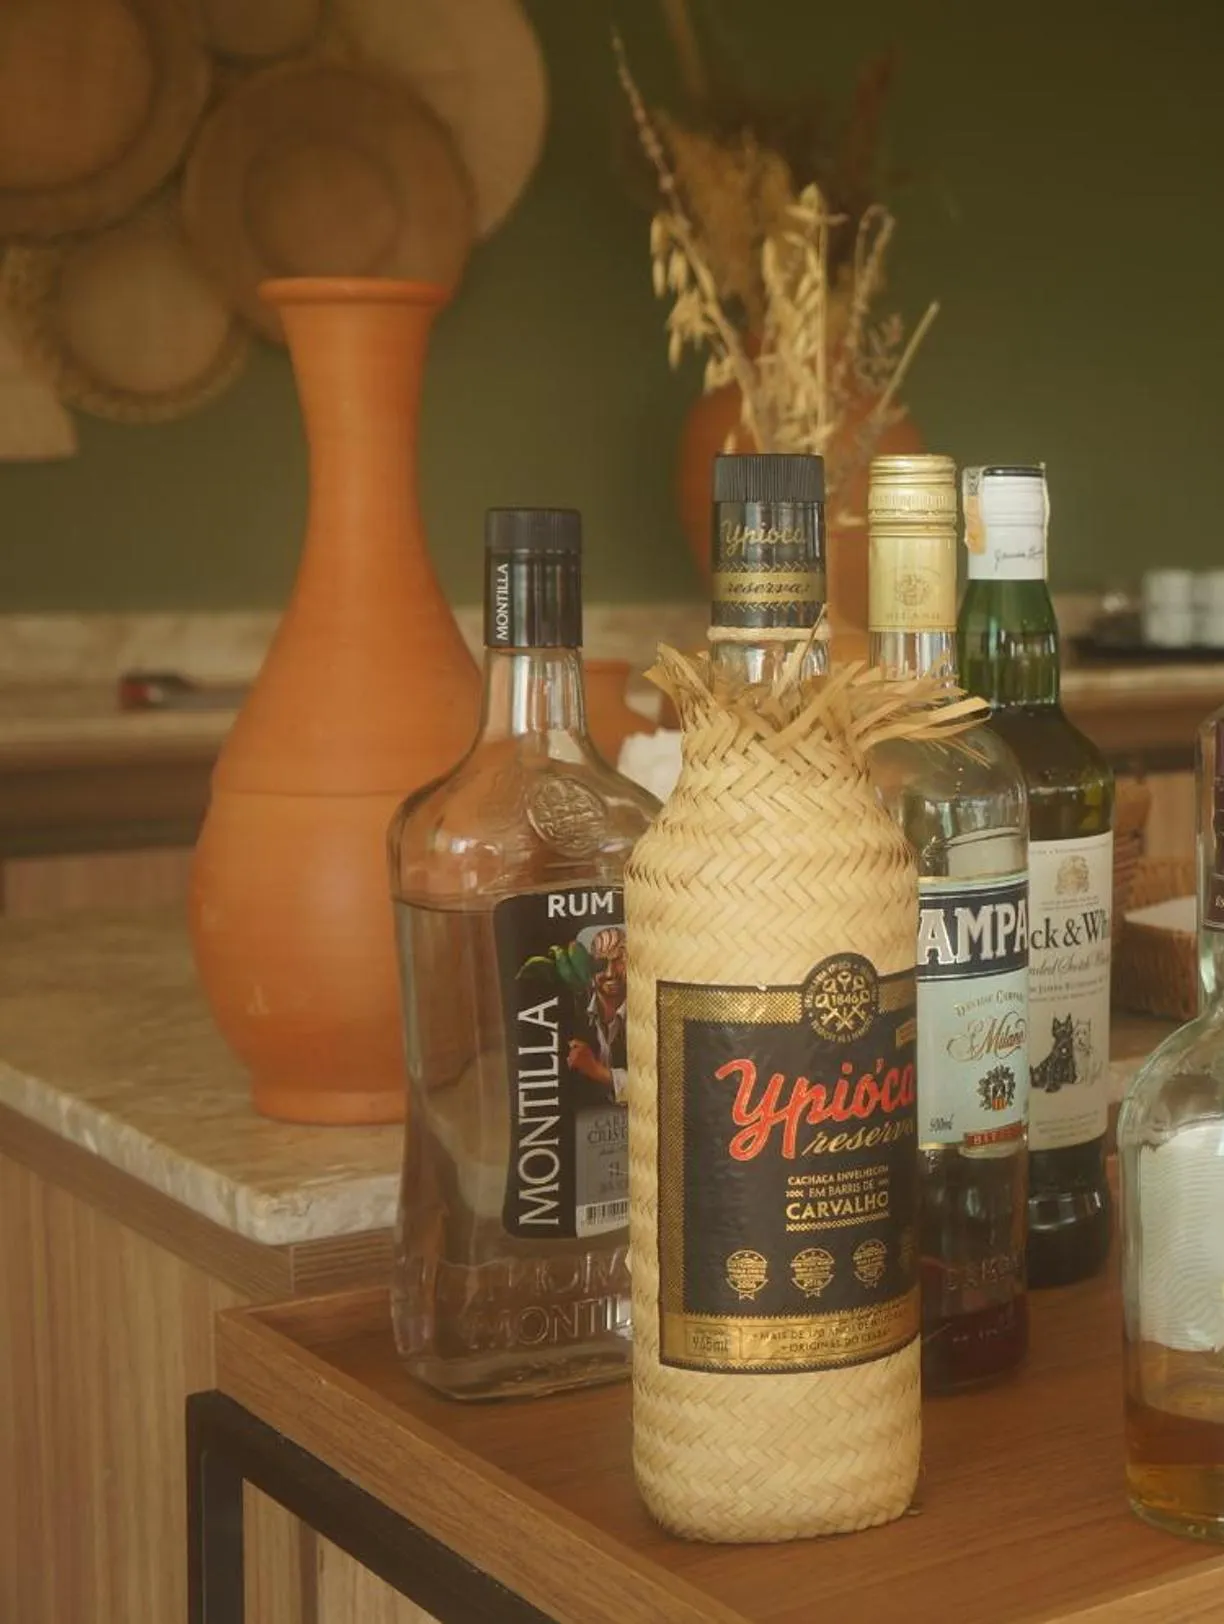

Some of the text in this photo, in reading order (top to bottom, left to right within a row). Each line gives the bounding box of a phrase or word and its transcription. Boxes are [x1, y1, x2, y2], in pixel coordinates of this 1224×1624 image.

[495, 563, 509, 641] MONTILLA
[547, 891, 614, 918] RUM
[517, 997, 561, 1226] MONTILLA
[808, 1186, 826, 1198] EM
[828, 1182, 861, 1197] BARRIS
[785, 1191, 889, 1221] CARVALHO
